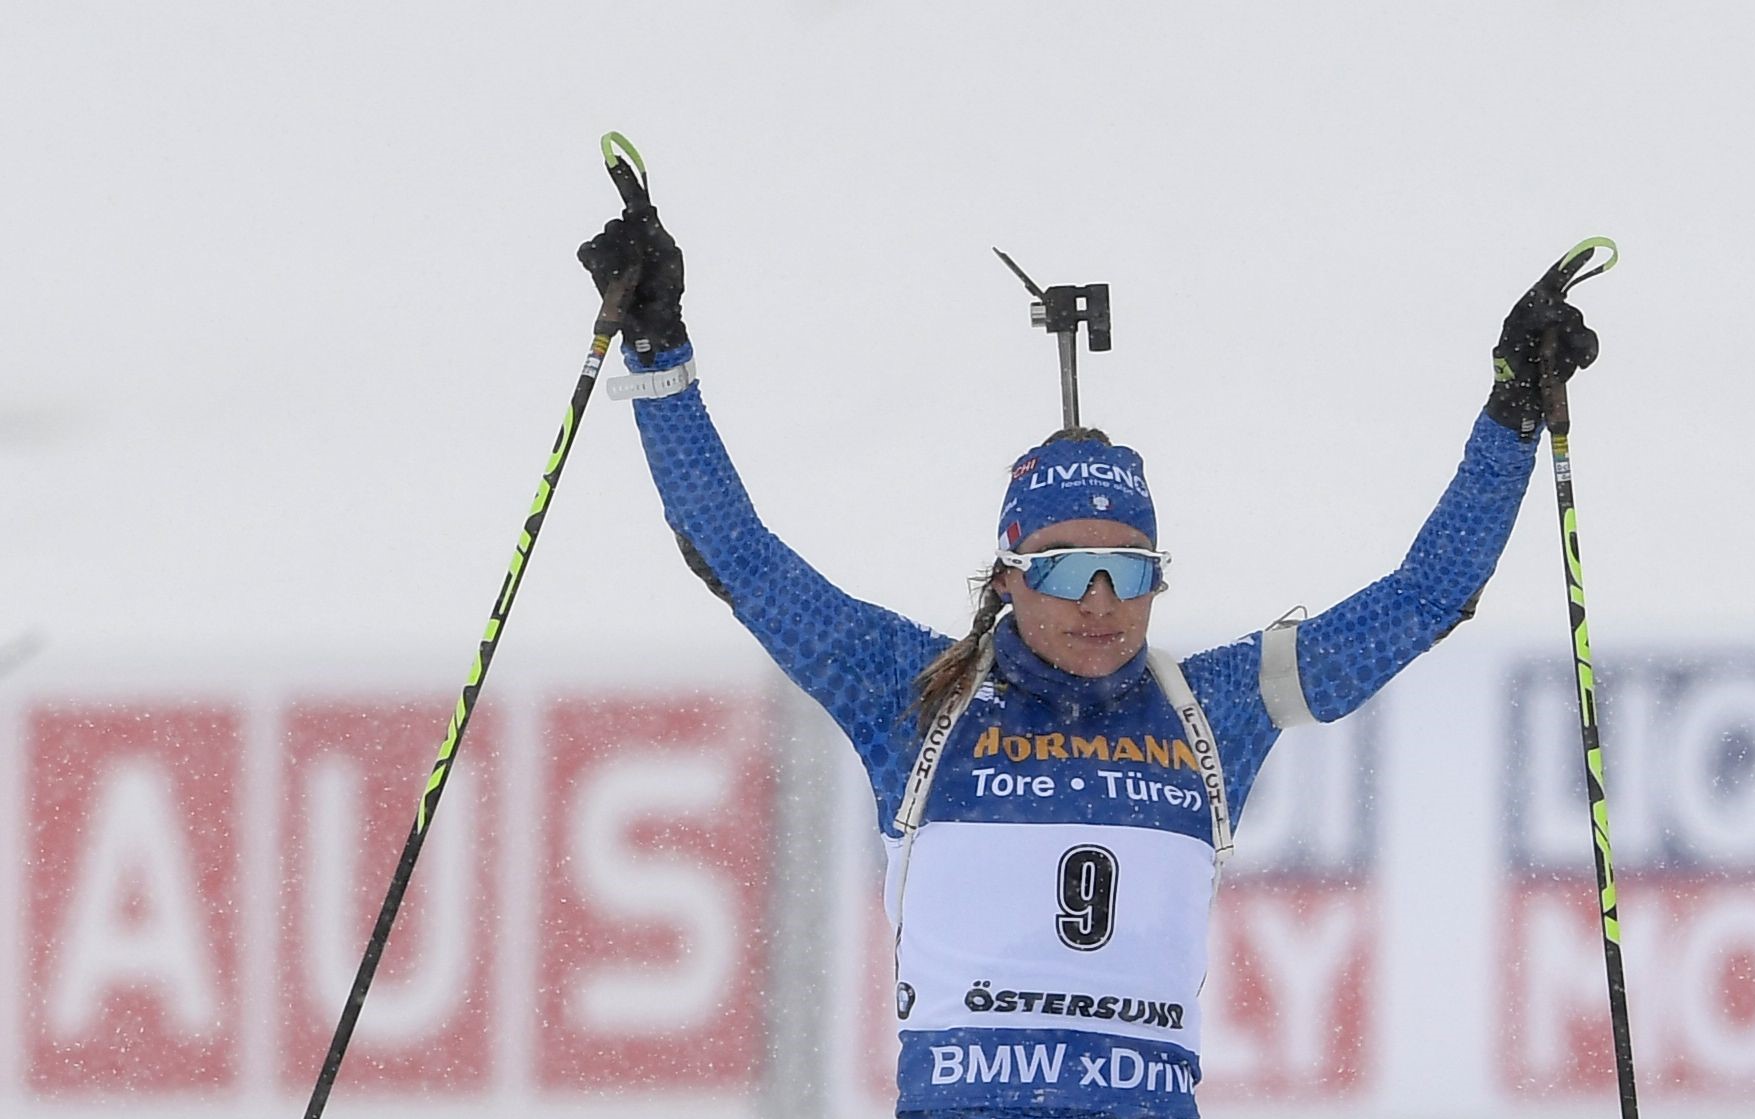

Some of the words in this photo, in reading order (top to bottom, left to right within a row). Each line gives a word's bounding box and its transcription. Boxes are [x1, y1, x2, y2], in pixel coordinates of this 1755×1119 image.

[972, 768, 1056, 796] Tore
[1098, 770, 1203, 812] Türen
[1182, 707, 1223, 822] FIOCCHI
[1056, 844, 1119, 952] 9
[930, 1044, 1067, 1085] BMW
